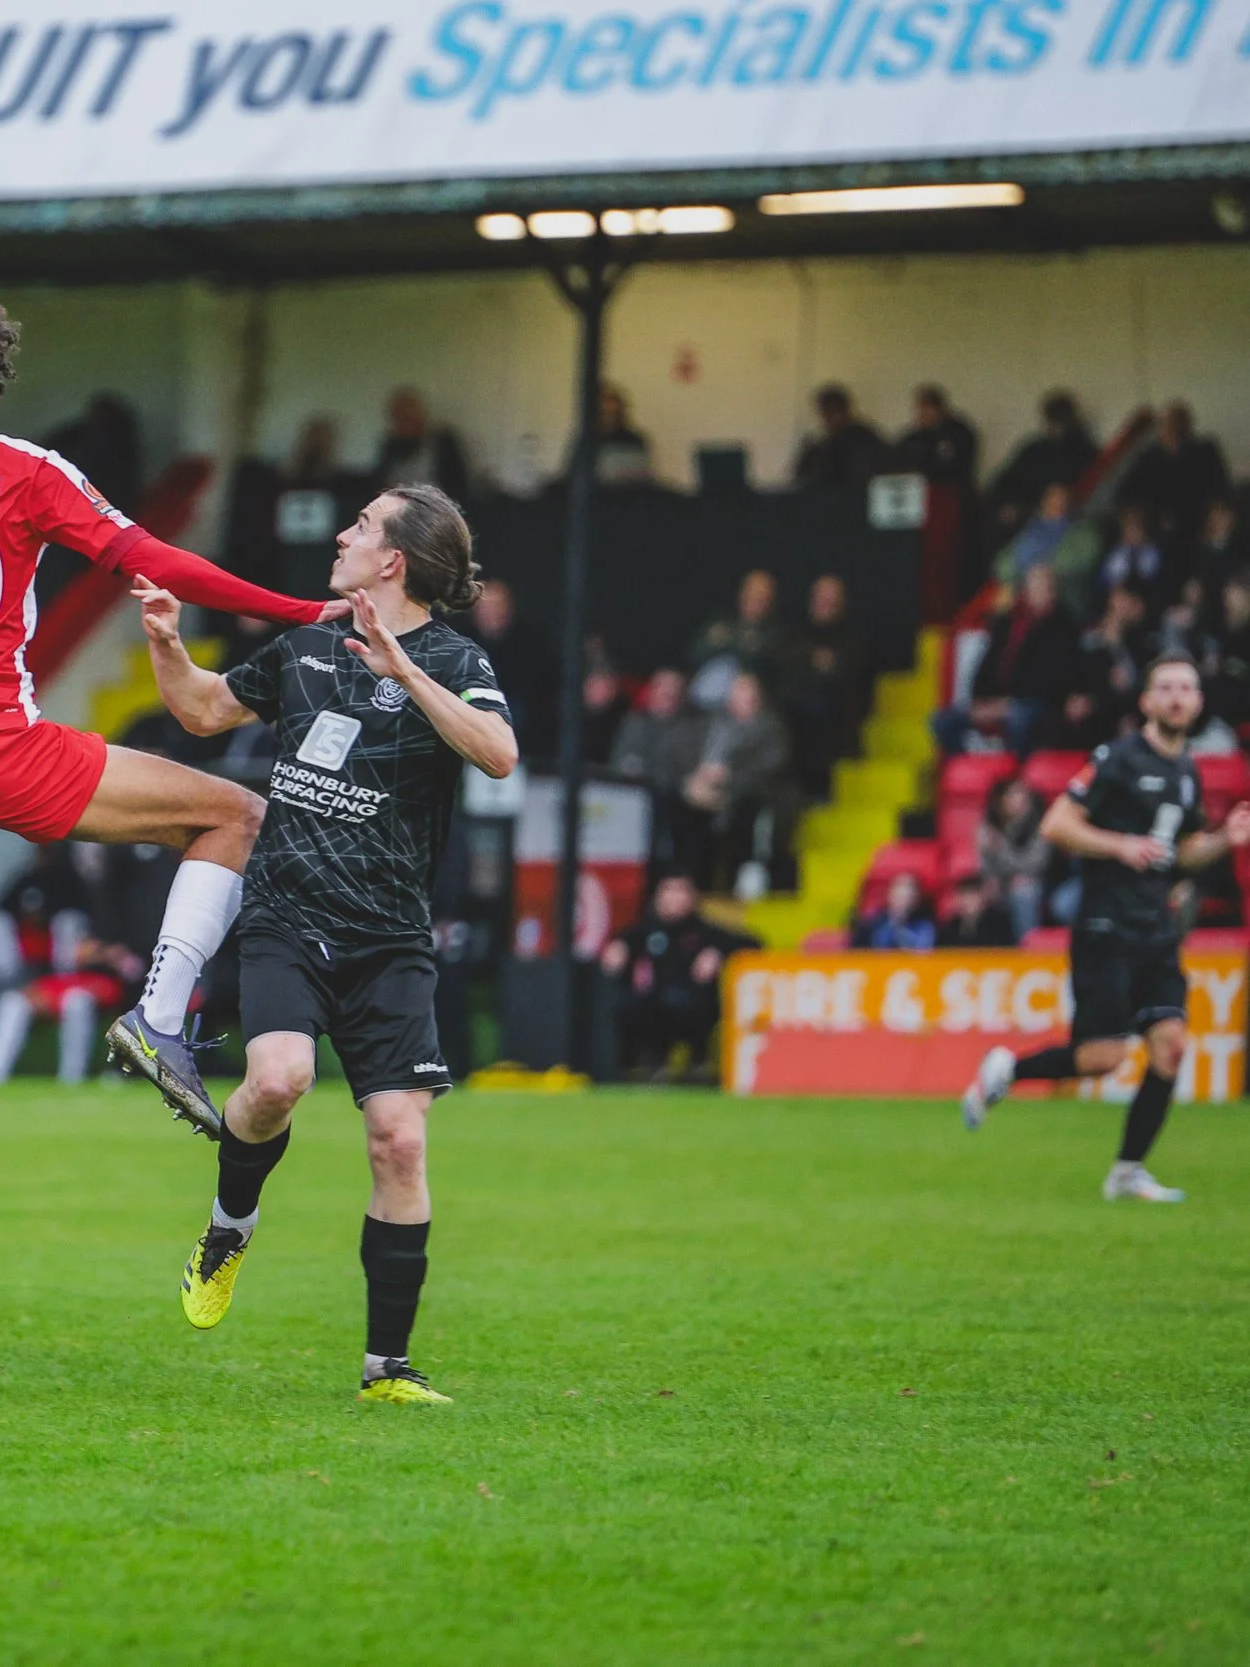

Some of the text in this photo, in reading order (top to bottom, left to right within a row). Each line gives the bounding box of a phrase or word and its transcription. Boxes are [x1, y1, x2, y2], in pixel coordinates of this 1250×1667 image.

[155, 26, 391, 141] you
[405, 0, 1062, 124] Specialists
[272, 761, 390, 804] HORNBURY
[735, 967, 867, 1033] FIRE
[880, 967, 925, 1033] &
